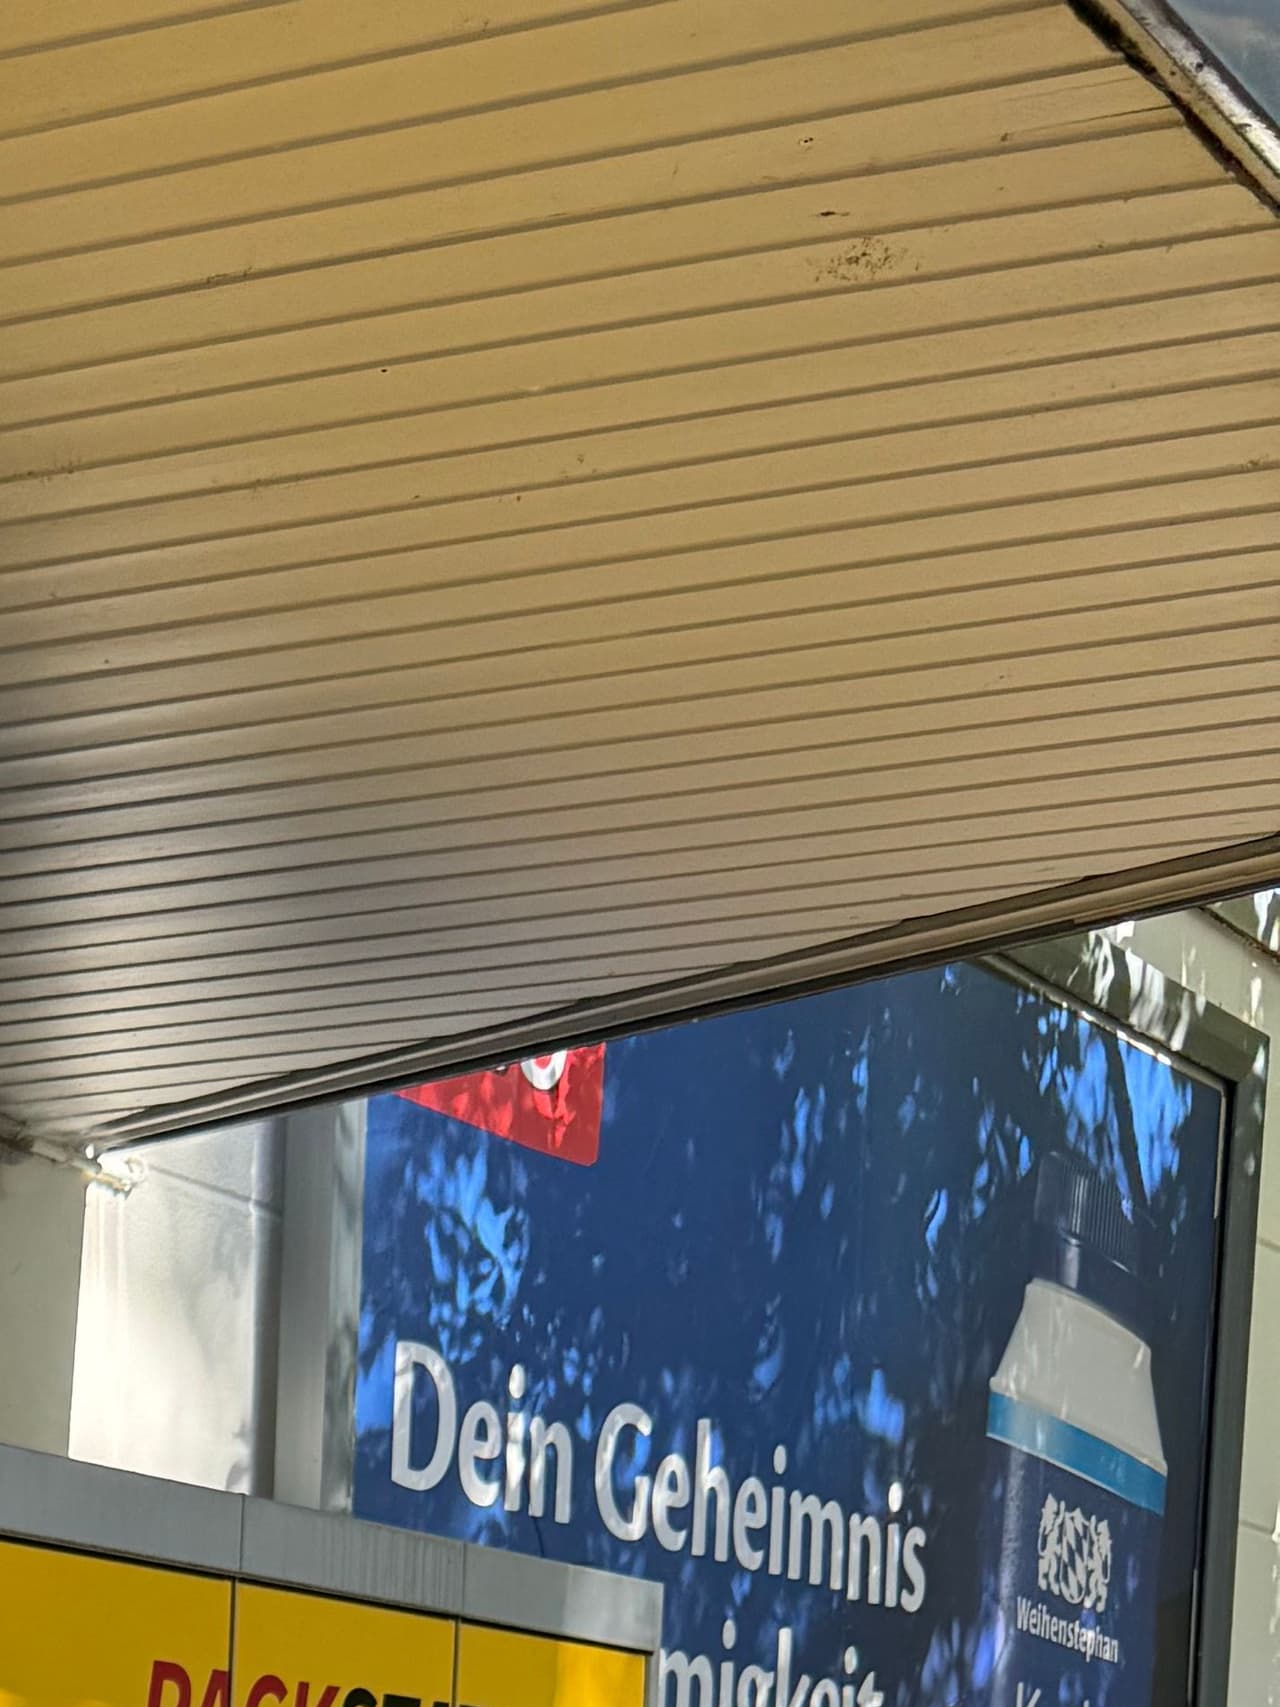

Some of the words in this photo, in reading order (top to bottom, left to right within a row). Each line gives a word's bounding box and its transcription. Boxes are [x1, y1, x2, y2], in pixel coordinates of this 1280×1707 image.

[391, 1340, 573, 1524] Dein
[595, 1402, 927, 1613] Geheimnis
[1017, 1595, 1119, 1663] Weihenstephan
